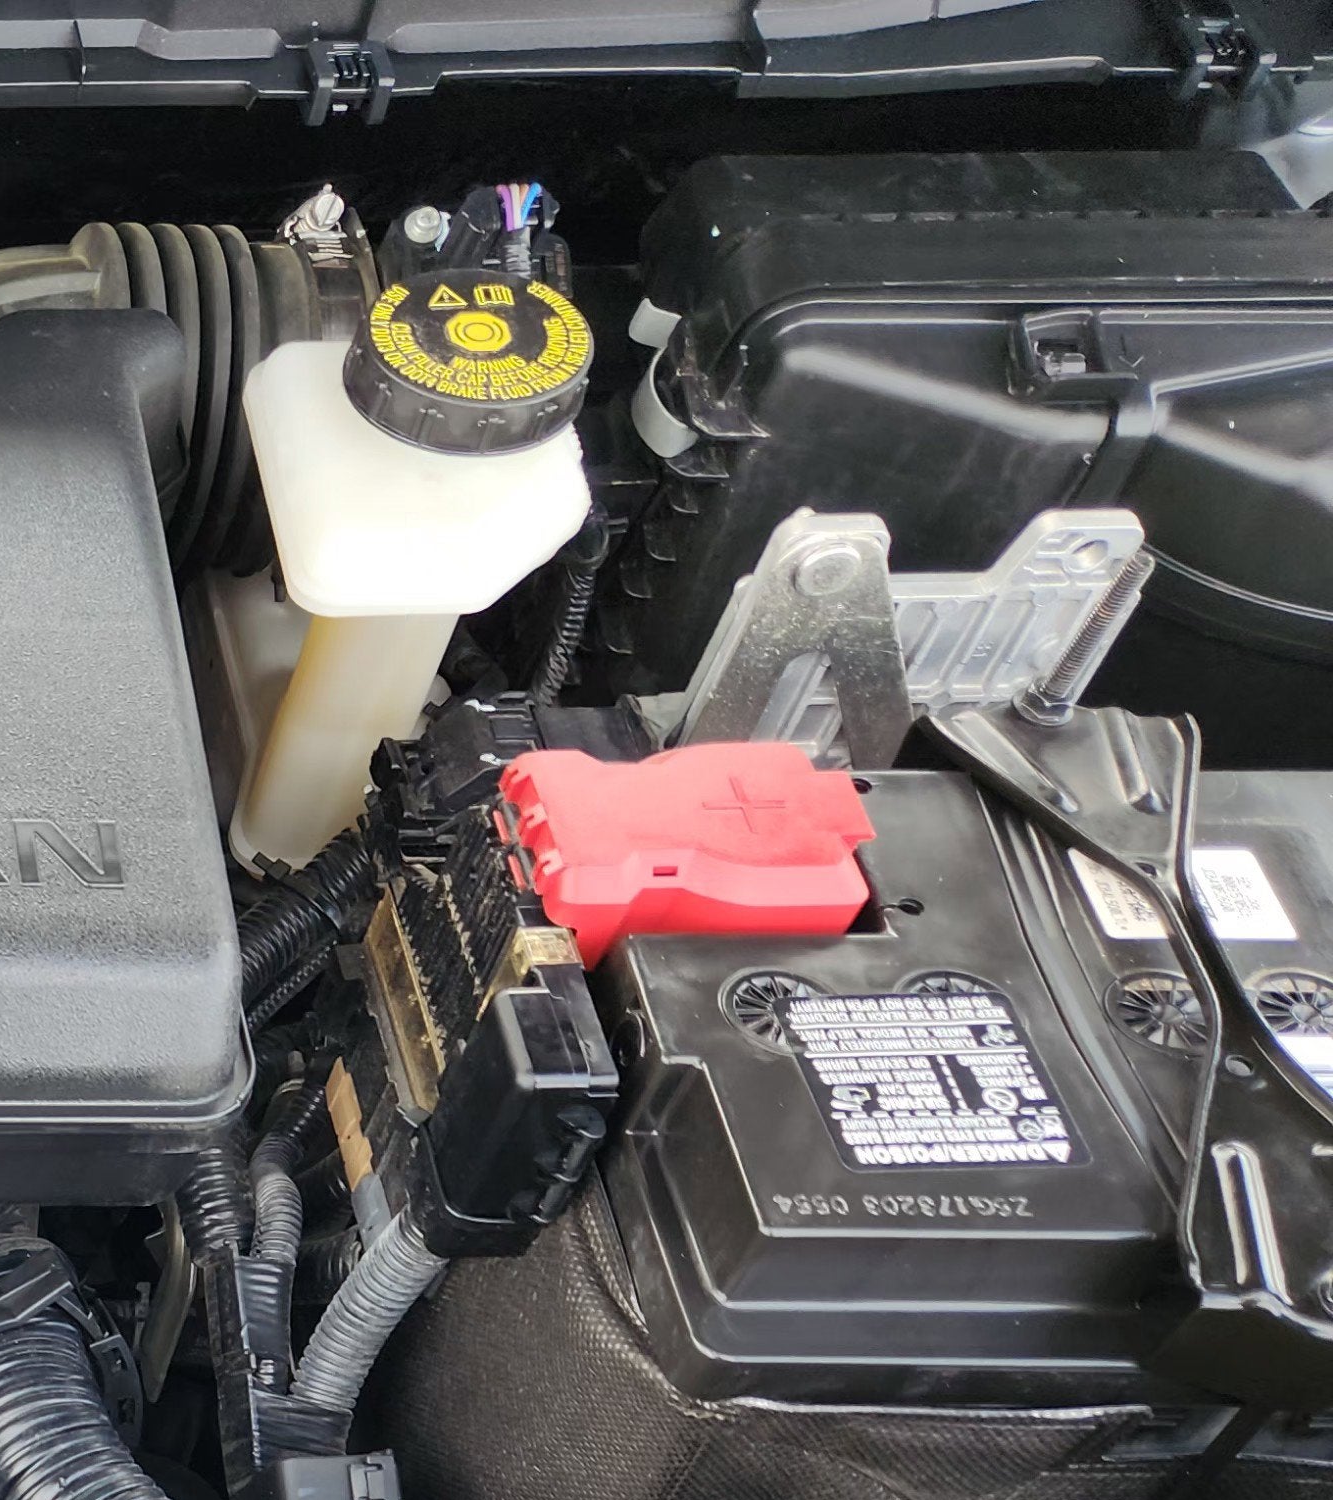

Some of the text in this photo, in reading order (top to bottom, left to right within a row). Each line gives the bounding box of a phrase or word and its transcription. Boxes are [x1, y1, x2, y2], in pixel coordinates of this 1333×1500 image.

[452, 353, 527, 375] WARNING
[457, 371, 488, 387] CAP
[490, 361, 550, 387] BEFORE
[435, 379, 489, 400] BRAKE
[489, 383, 534, 401] FLUID
[528, 367, 573, 394] FROM
[879, 998, 907, 1011] NOT
[903, 997, 927, 1010] DO
[947, 996, 974, 1009] NOT
[970, 996, 994, 1009] DO
[868, 1010, 908, 1022] REACH
[907, 1010, 933, 1021] THE
[933, 1009, 950, 1021] OF
[950, 1008, 978, 1020] OUT
[974, 1007, 1010, 1020] KEEP
[826, 1028, 859, 1041] HELP
[854, 1027, 908, 1040] MEDICAL
[838, 1039, 912, 1051] IMMEDIATELY
[910, 1038, 942, 1050] EYES
[941, 1038, 979, 1049] FLUSH
[811, 1056, 932, 1072] OR SEVERE BURNS
[955, 1053, 1020, 1067] SMOKING
[818, 1069, 938, 1085] CAUSE BLINDNESS
[970, 1065, 1026, 1077] FLAMES
[976, 1075, 1031, 1088] SPARKS
[875, 1083, 906, 1097] CAN
[852, 1142, 1050, 1165] DANGER/POISON
